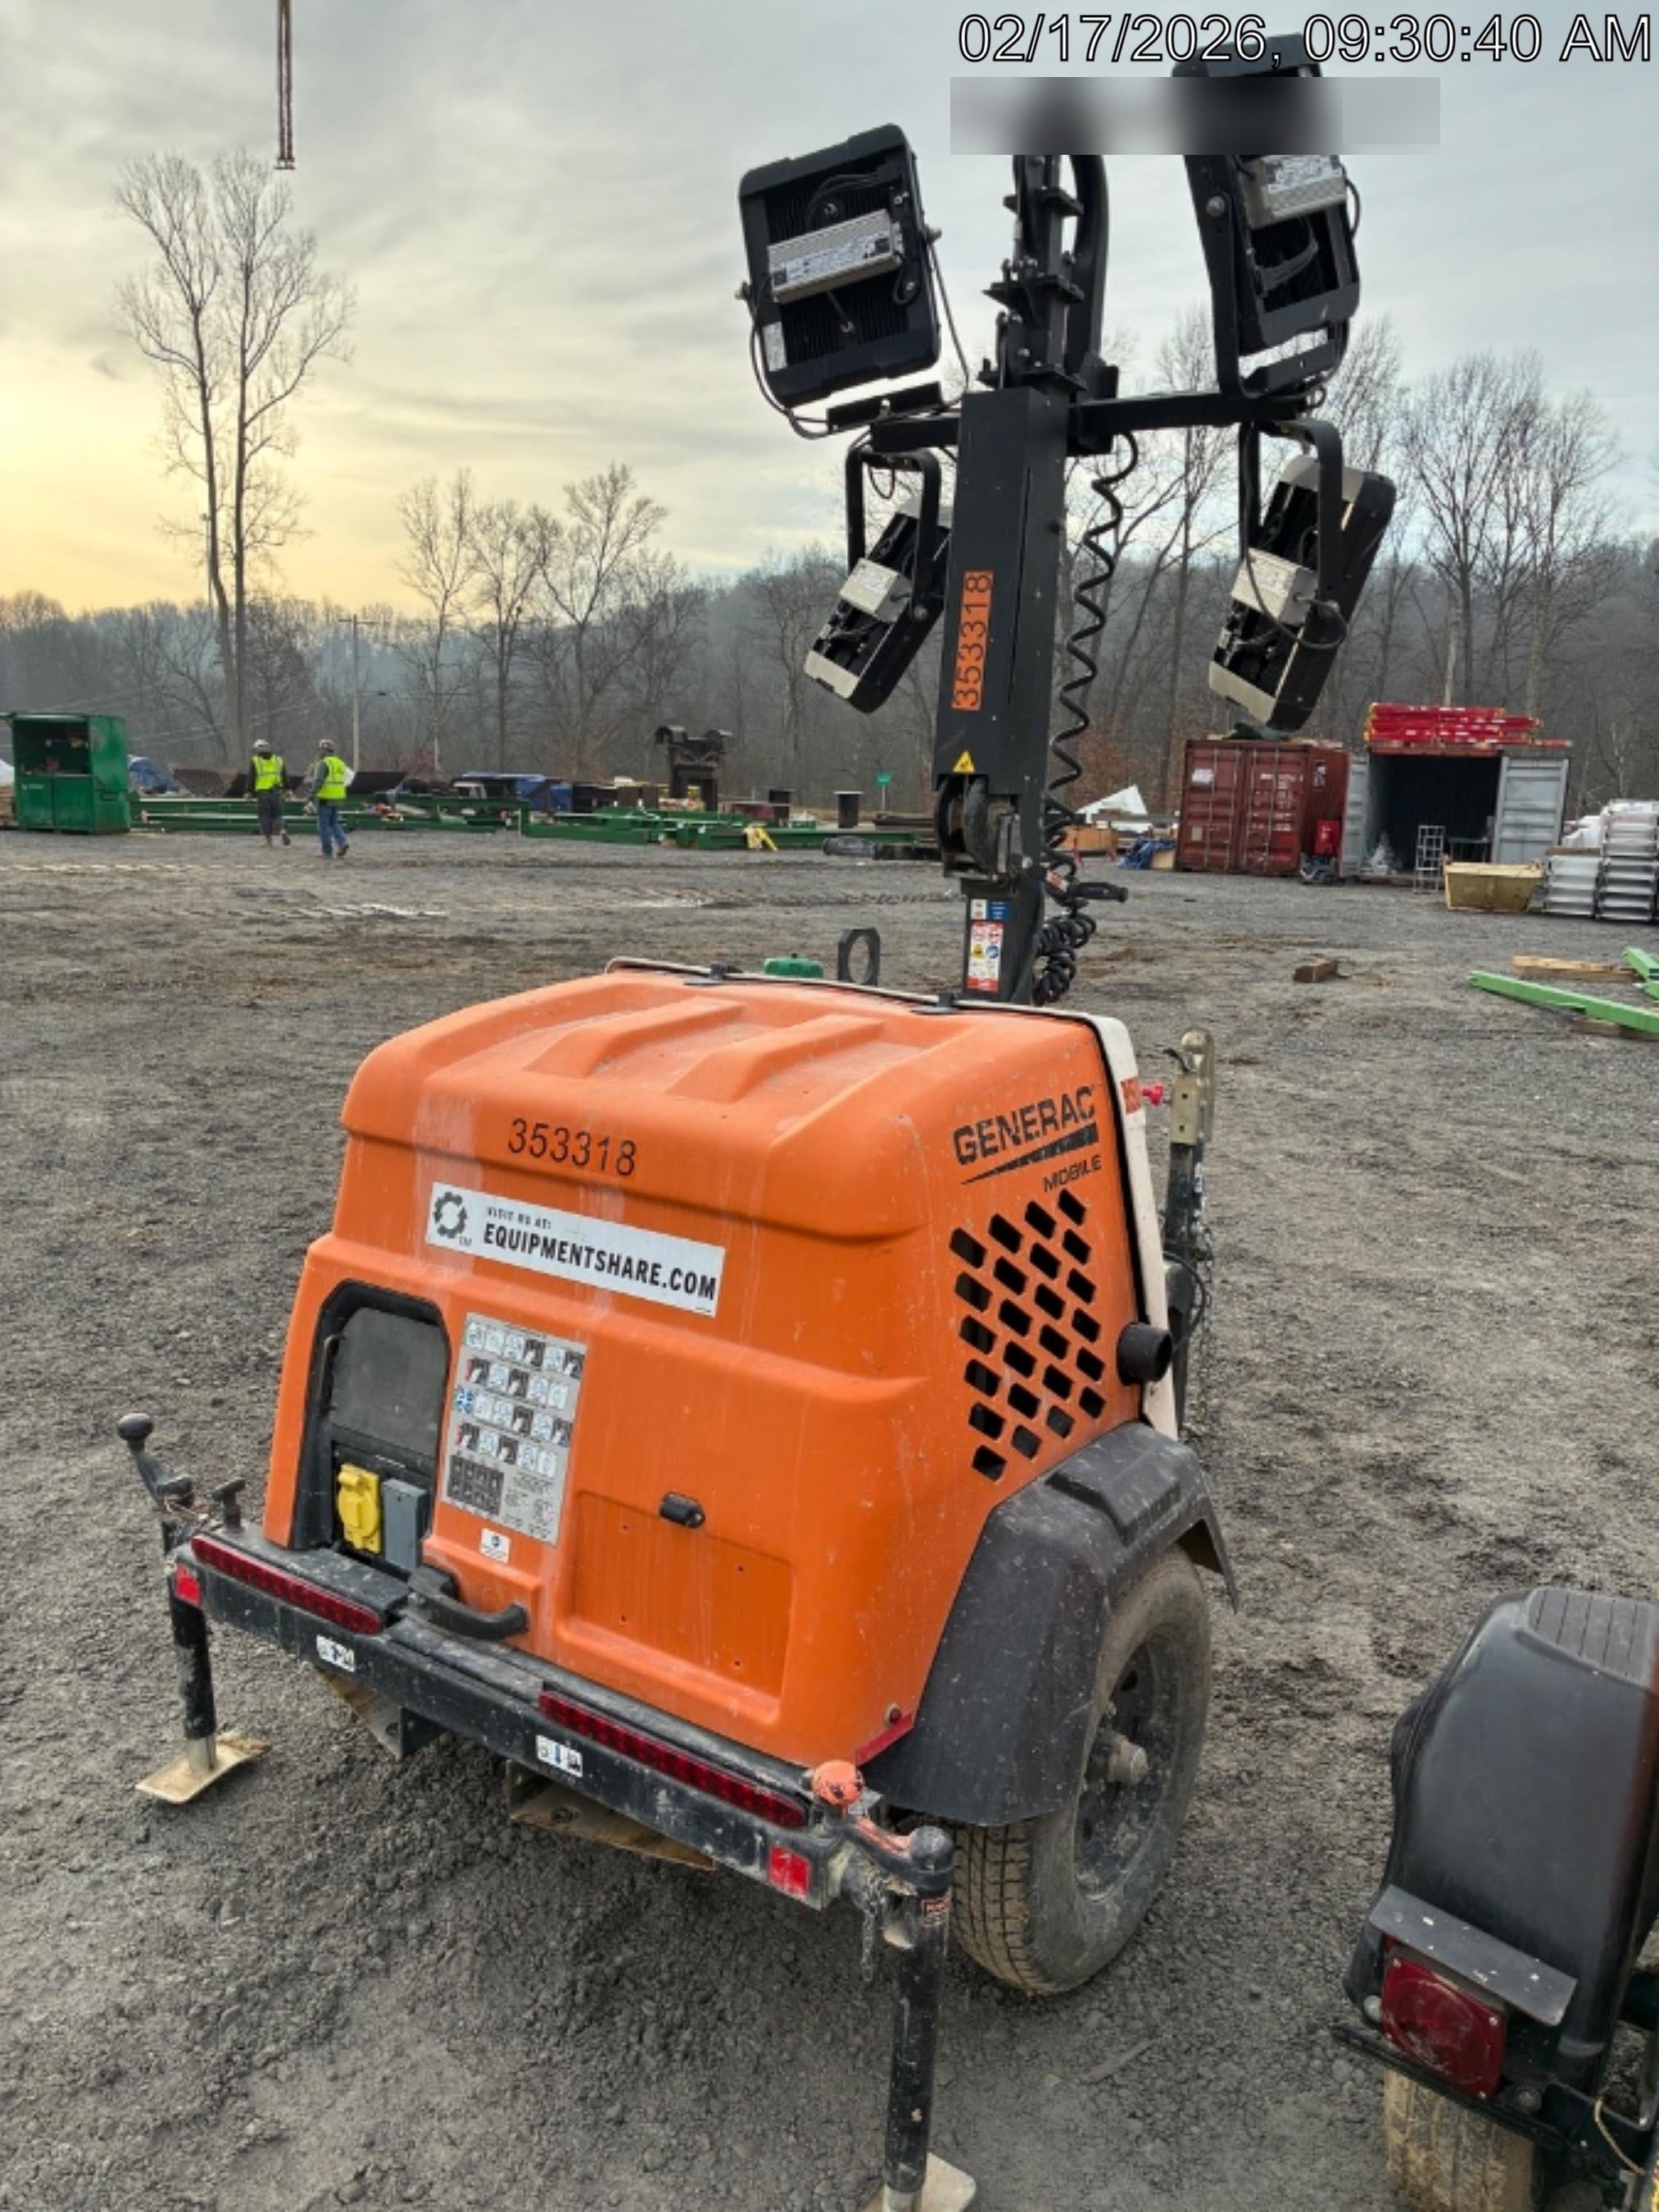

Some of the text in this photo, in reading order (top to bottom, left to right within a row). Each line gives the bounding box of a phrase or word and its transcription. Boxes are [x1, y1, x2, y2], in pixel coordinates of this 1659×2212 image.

[955, 575, 990, 706] 353318
[508, 1117, 637, 1176] 353318
[953, 1086, 1095, 1166] GENERAC
[1042, 1154, 1102, 1193] MOBILE
[487, 1206, 514, 1222] VISIT
[483, 1222, 716, 1301] EQUIPMENTSHARE.COM
